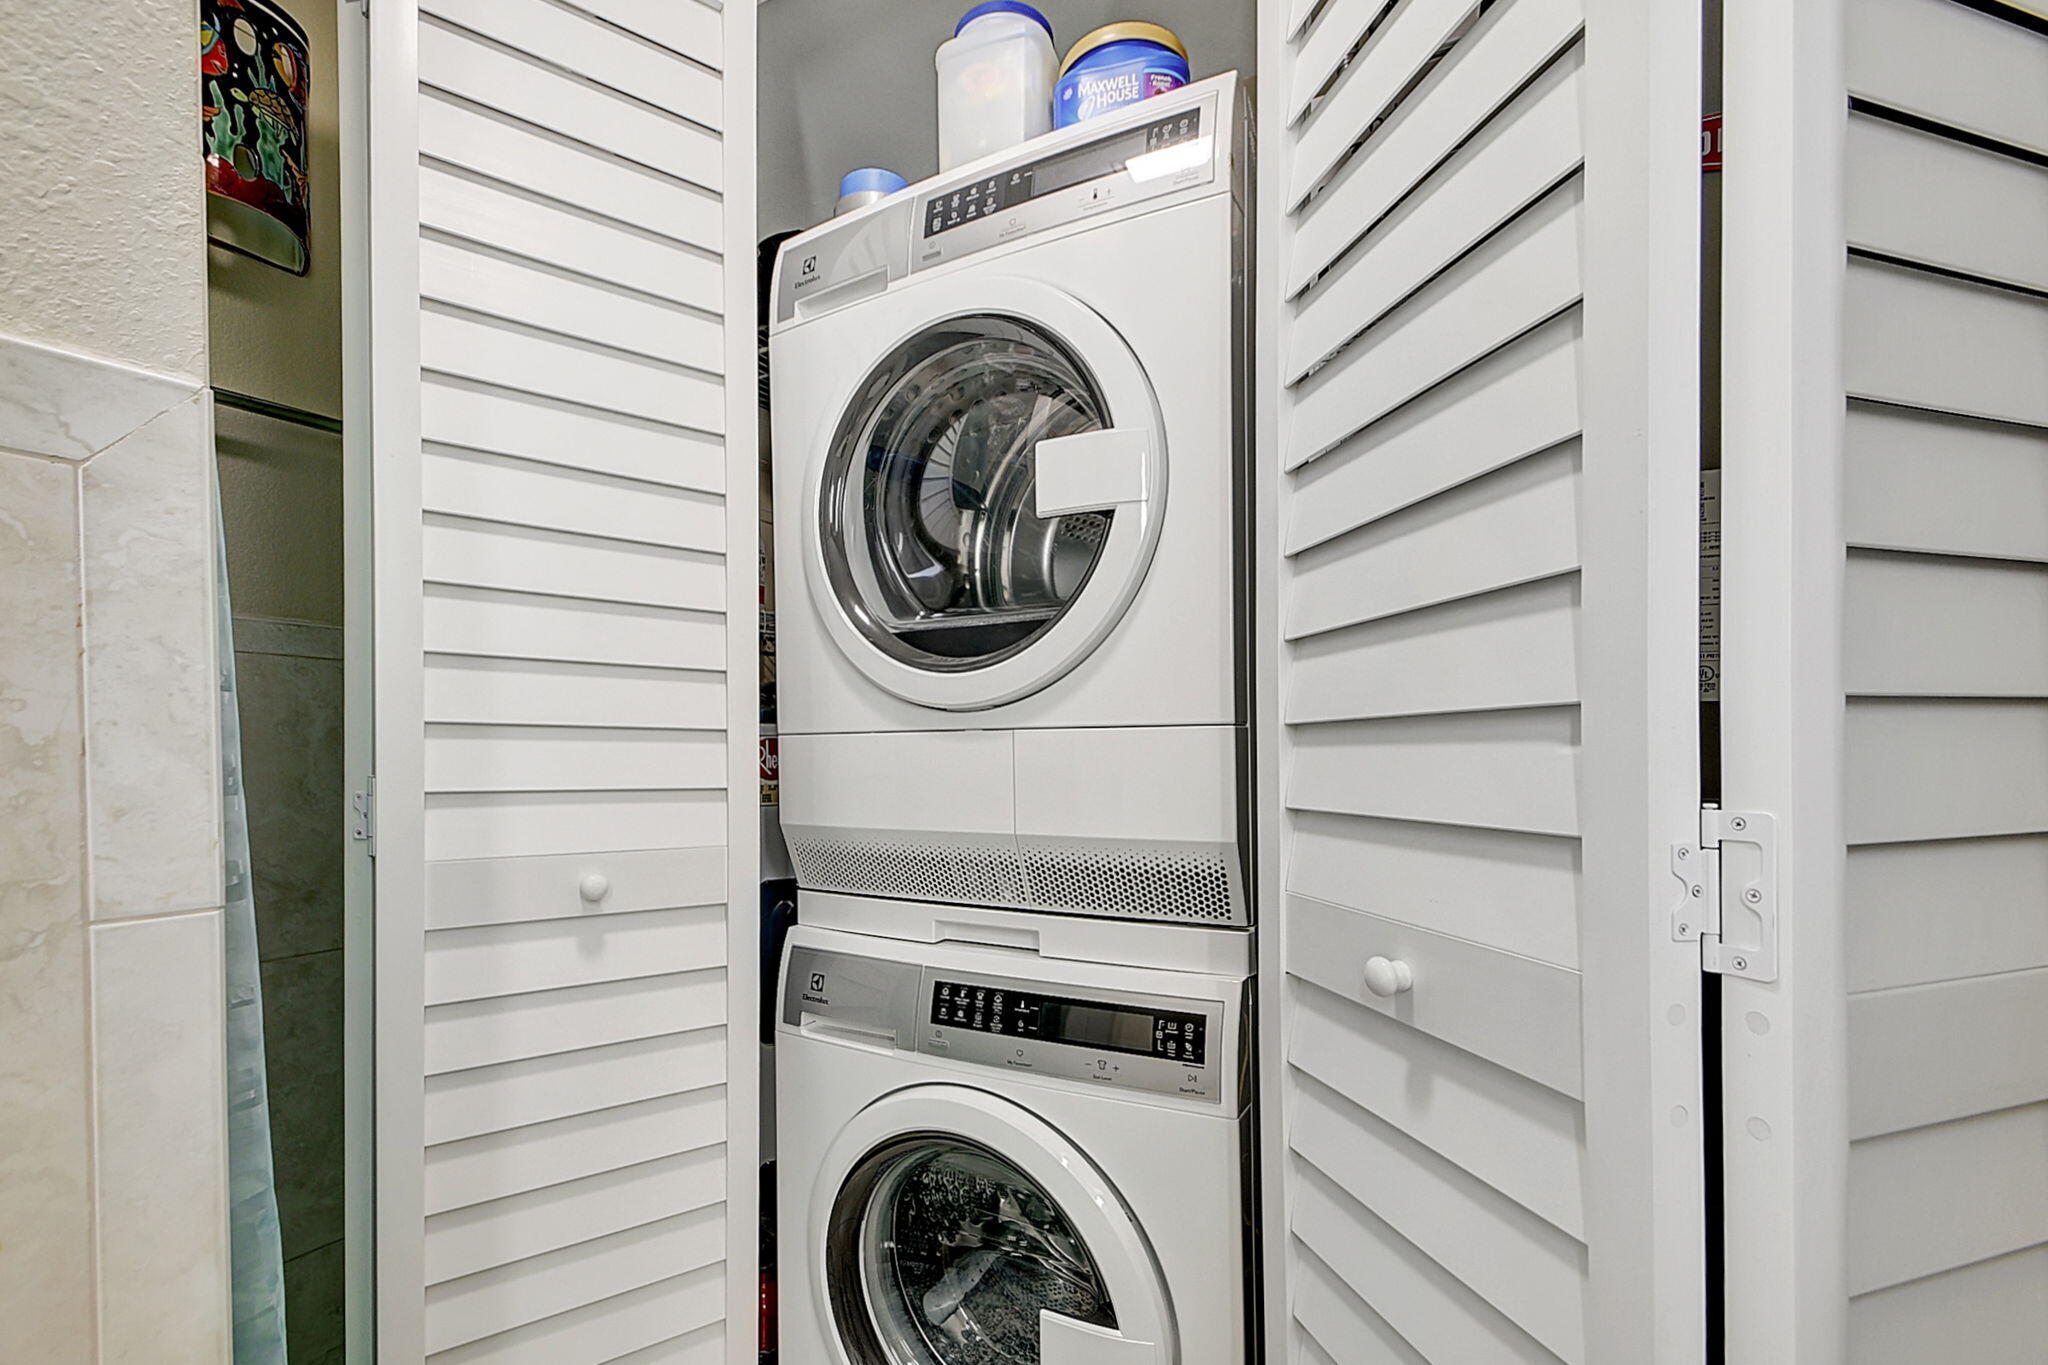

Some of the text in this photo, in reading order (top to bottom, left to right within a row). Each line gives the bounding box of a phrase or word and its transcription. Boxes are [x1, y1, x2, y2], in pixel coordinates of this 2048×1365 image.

[1078, 73, 1140, 98] MAXWELL
[1096, 86, 1140, 108] HOUSE
[801, 993, 830, 1005] Electrolux
